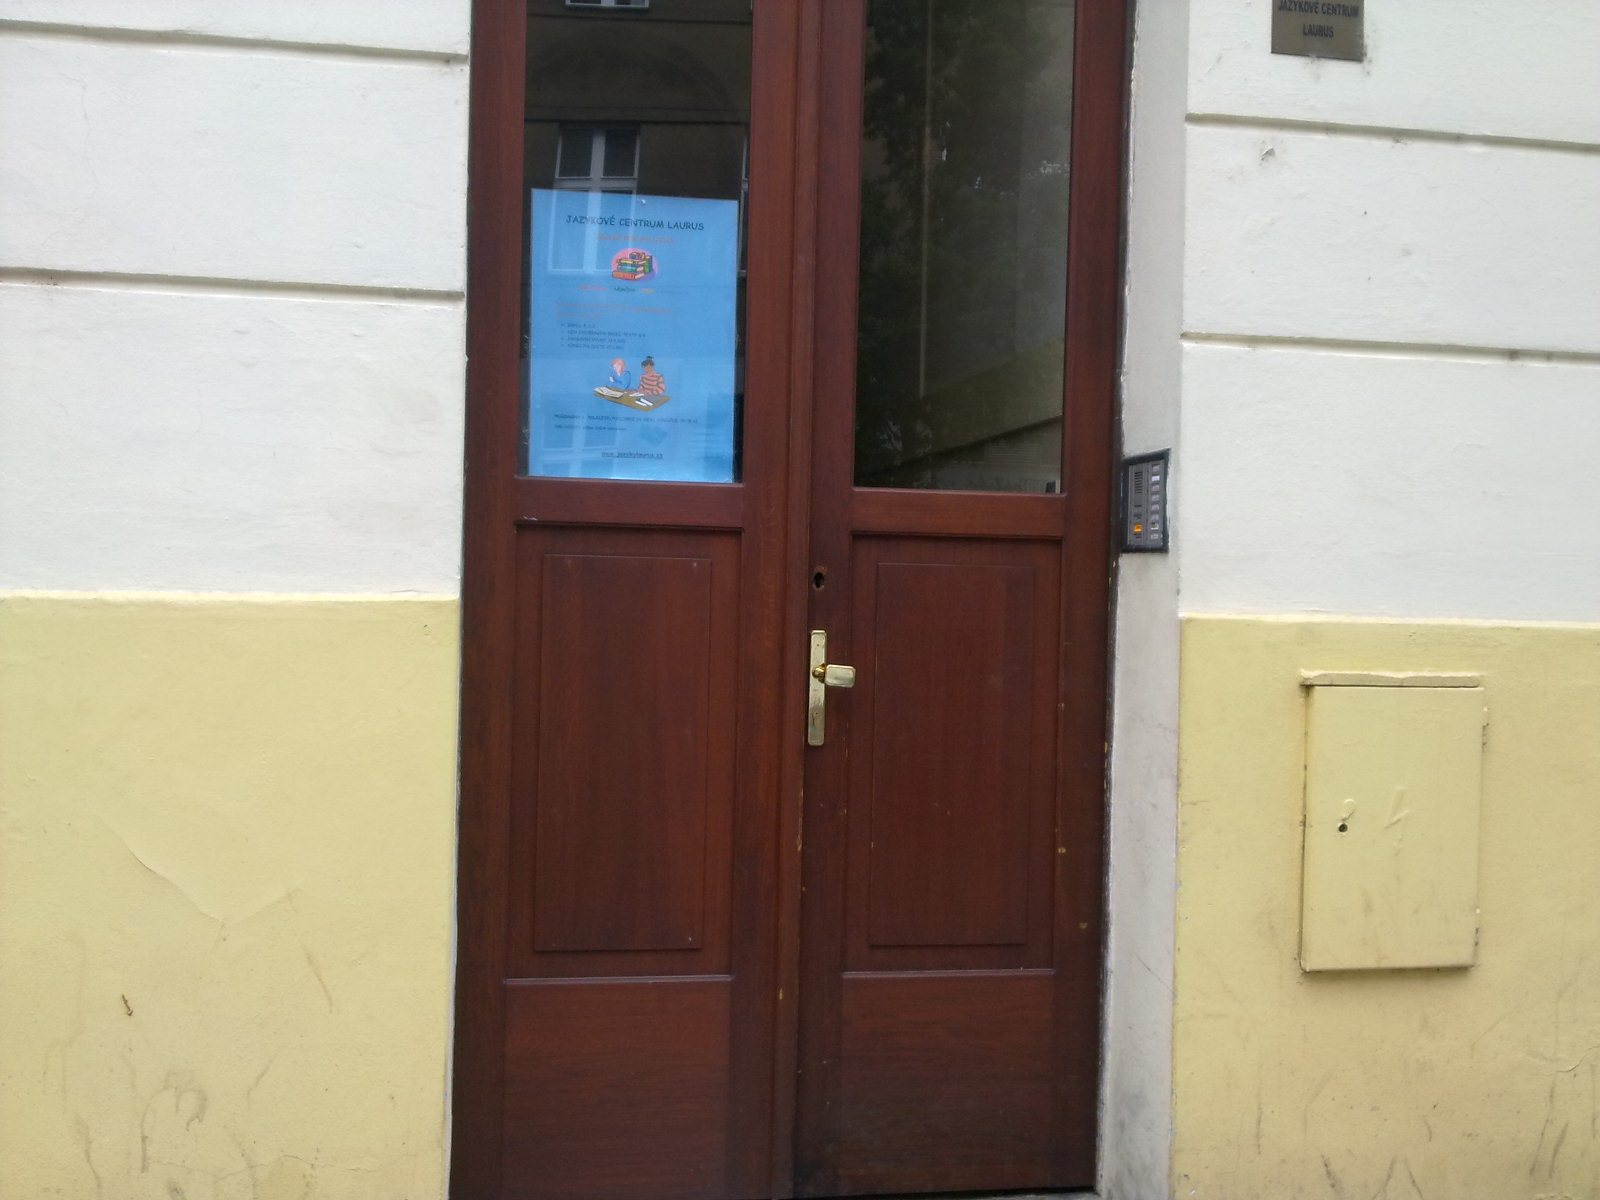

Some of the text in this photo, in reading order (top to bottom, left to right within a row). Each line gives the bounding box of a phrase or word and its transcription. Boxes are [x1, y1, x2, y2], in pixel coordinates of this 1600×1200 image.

[1321, 3, 1359, 17] CENTRUM
[1303, 24, 1334, 38] LAURUS
[566, 214, 705, 232] JAZYKOVÉ CENTRUM LAURUS
